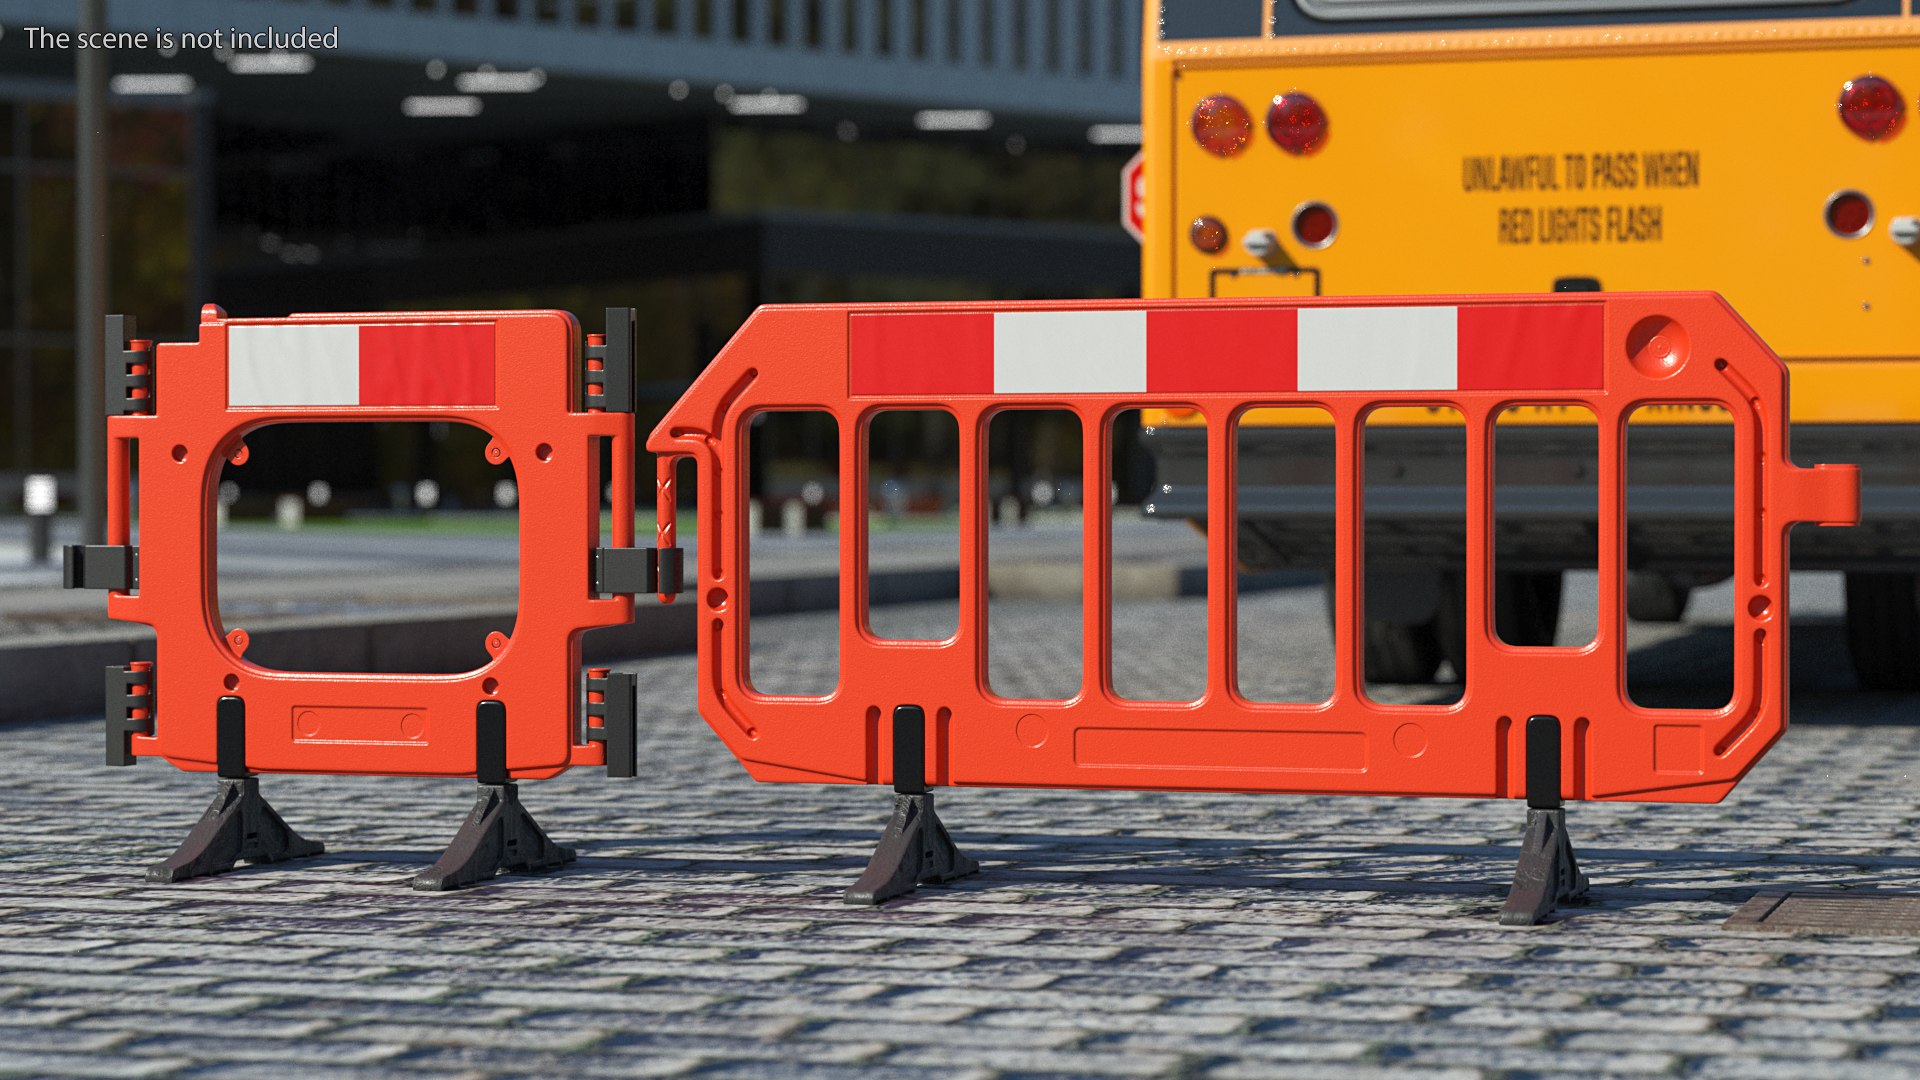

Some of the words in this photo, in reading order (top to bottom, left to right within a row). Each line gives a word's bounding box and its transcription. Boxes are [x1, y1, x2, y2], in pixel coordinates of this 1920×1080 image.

[1462, 155, 1559, 192] UNLAWFUL
[1564, 152, 1587, 190] TO
[1591, 151, 1639, 188] PASS
[1641, 150, 1700, 187] WHEN
[1498, 207, 1534, 244] RED
[1538, 206, 1602, 243] LIGHTS
[1605, 204, 1662, 242] FLASH
